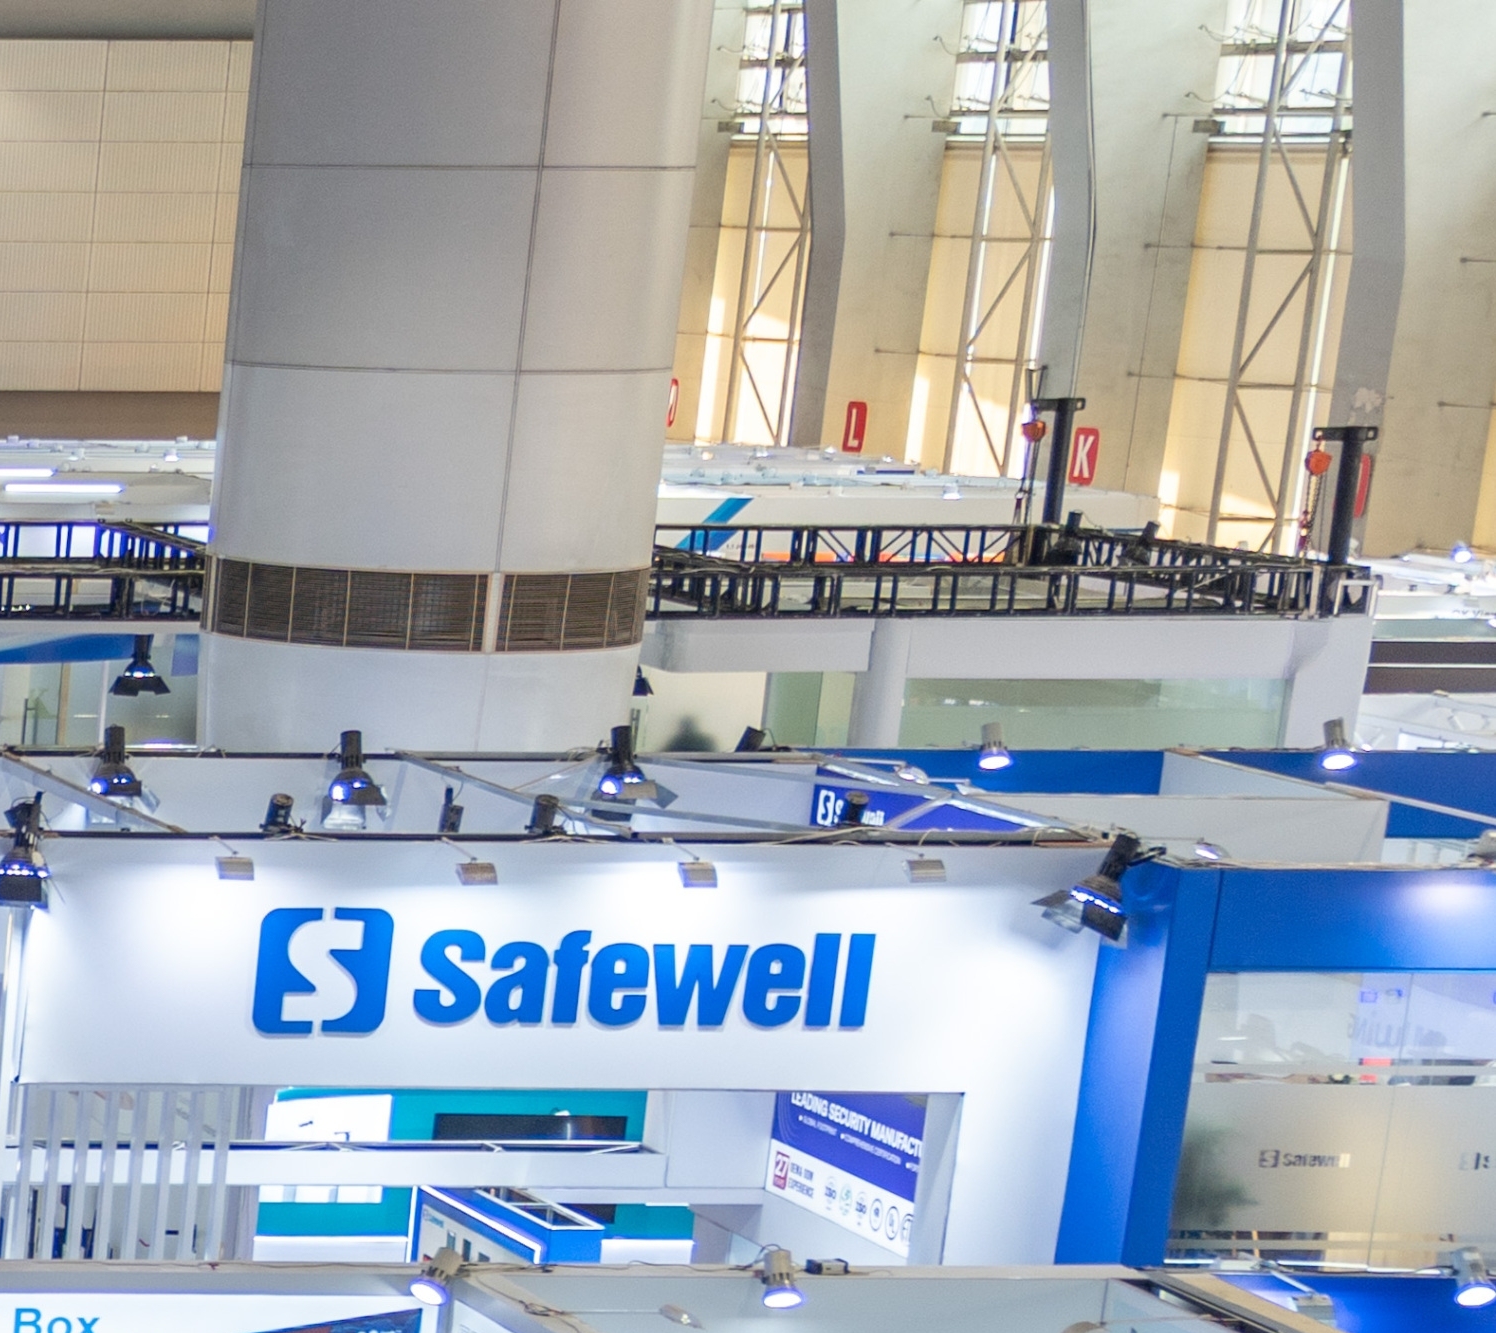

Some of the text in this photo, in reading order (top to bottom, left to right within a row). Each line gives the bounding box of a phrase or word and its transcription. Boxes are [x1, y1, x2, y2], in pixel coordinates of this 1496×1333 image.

[847, 408, 862, 446] L
[1072, 433, 1092, 477] K
[412, 927, 878, 1033] Safewell
[790, 1091, 829, 1119] LEADING
[828, 1103, 872, 1136] SECURITY
